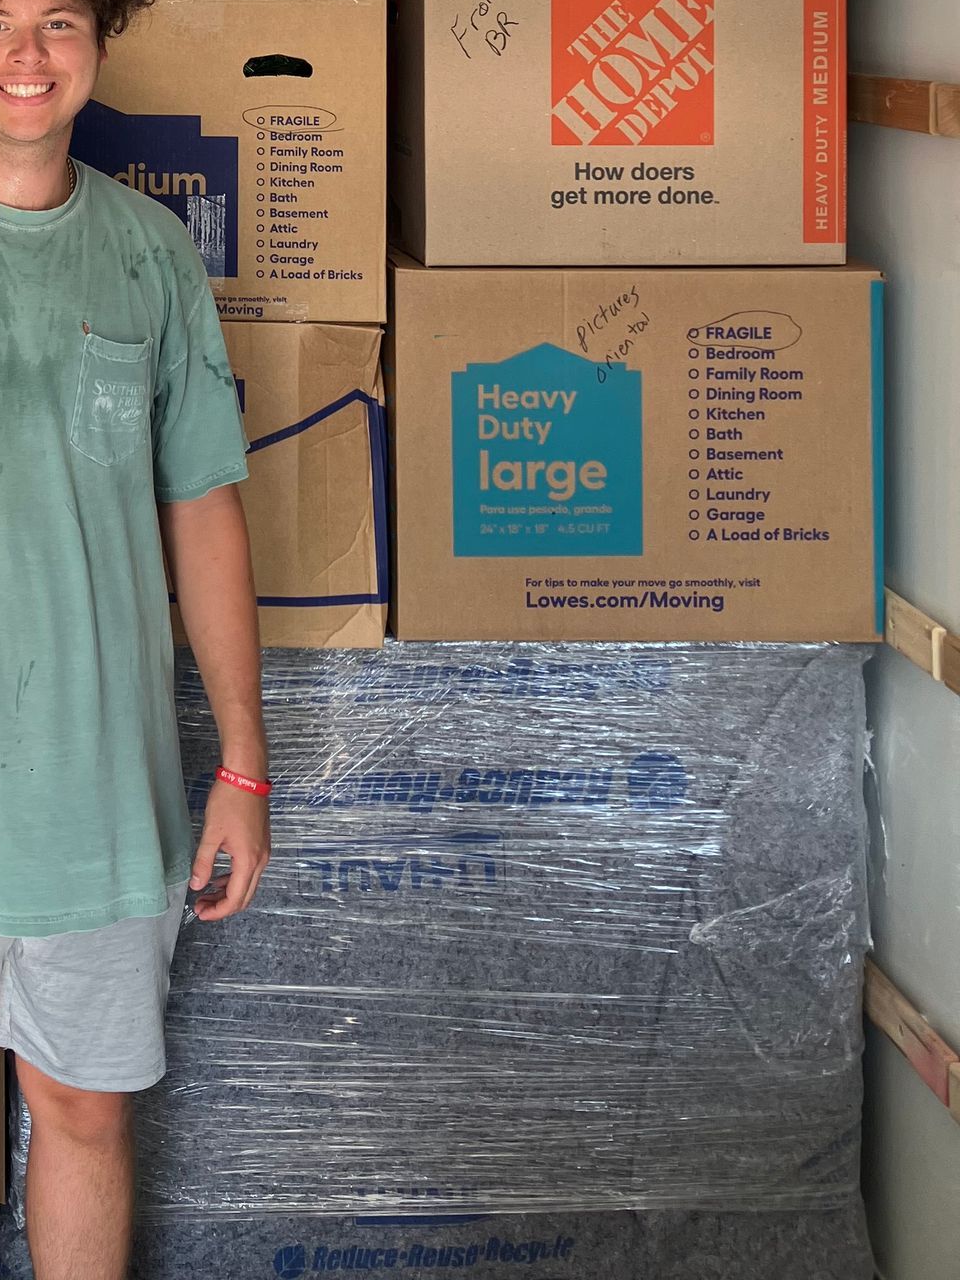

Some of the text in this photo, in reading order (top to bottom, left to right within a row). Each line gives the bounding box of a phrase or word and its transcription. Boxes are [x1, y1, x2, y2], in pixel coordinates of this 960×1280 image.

[485, 11, 519, 56] BR
[566, 0, 636, 64] THE
[615, 43, 715, 145] DEPOT
[270, 115, 320, 126] FRAGILE
[813, 11, 829, 230] HEAVY DUTY MEDIUM
[270, 131, 323, 142] Bedroom
[270, 147, 344, 158] Family Room
[270, 162, 343, 174] Dining Room
[574, 162, 695, 181] How doers
[269, 177, 315, 188] Kitchen
[269, 193, 298, 203] Bath
[551, 187, 588, 209] get
[593, 190, 652, 205] more
[269, 208, 329, 219] Basement
[269, 224, 298, 234] Attic
[269, 239, 319, 251] Laundry
[269, 254, 315, 267] Garage
[269, 270, 363, 280] A Load of Bricks
[706, 327, 772, 339] FRAGILE
[706, 348, 775, 360] Bedroom
[706, 368, 804, 382] Family Room
[478, 384, 577, 414] Heavy
[706, 388, 802, 403] Dining Room
[706, 408, 765, 420] Kitchen
[478, 414, 552, 445] Duty
[706, 428, 743, 440] Bath
[706, 448, 784, 460] Basement
[480, 450, 607, 501] large
[706, 468, 744, 480] Attic
[706, 488, 771, 503] Laundry
[480, 504, 505, 514] Para
[706, 509, 765, 523] Garage
[577, 524, 594, 534] CU
[597, 523, 610, 534] FT
[706, 528, 830, 541] A Load of Bricks
[526, 578, 542, 587] For
[545, 578, 564, 589] tips
[567, 579, 578, 587] to
[580, 578, 609, 587] make
[612, 580, 636, 589] your
[668, 580, 683, 589] go
[685, 578, 736, 589] smoothly,
[739, 578, 761, 588] visit
[526, 591, 725, 612] Lowes.com/Moving
[237, 777, 257, 791] Isaiah
